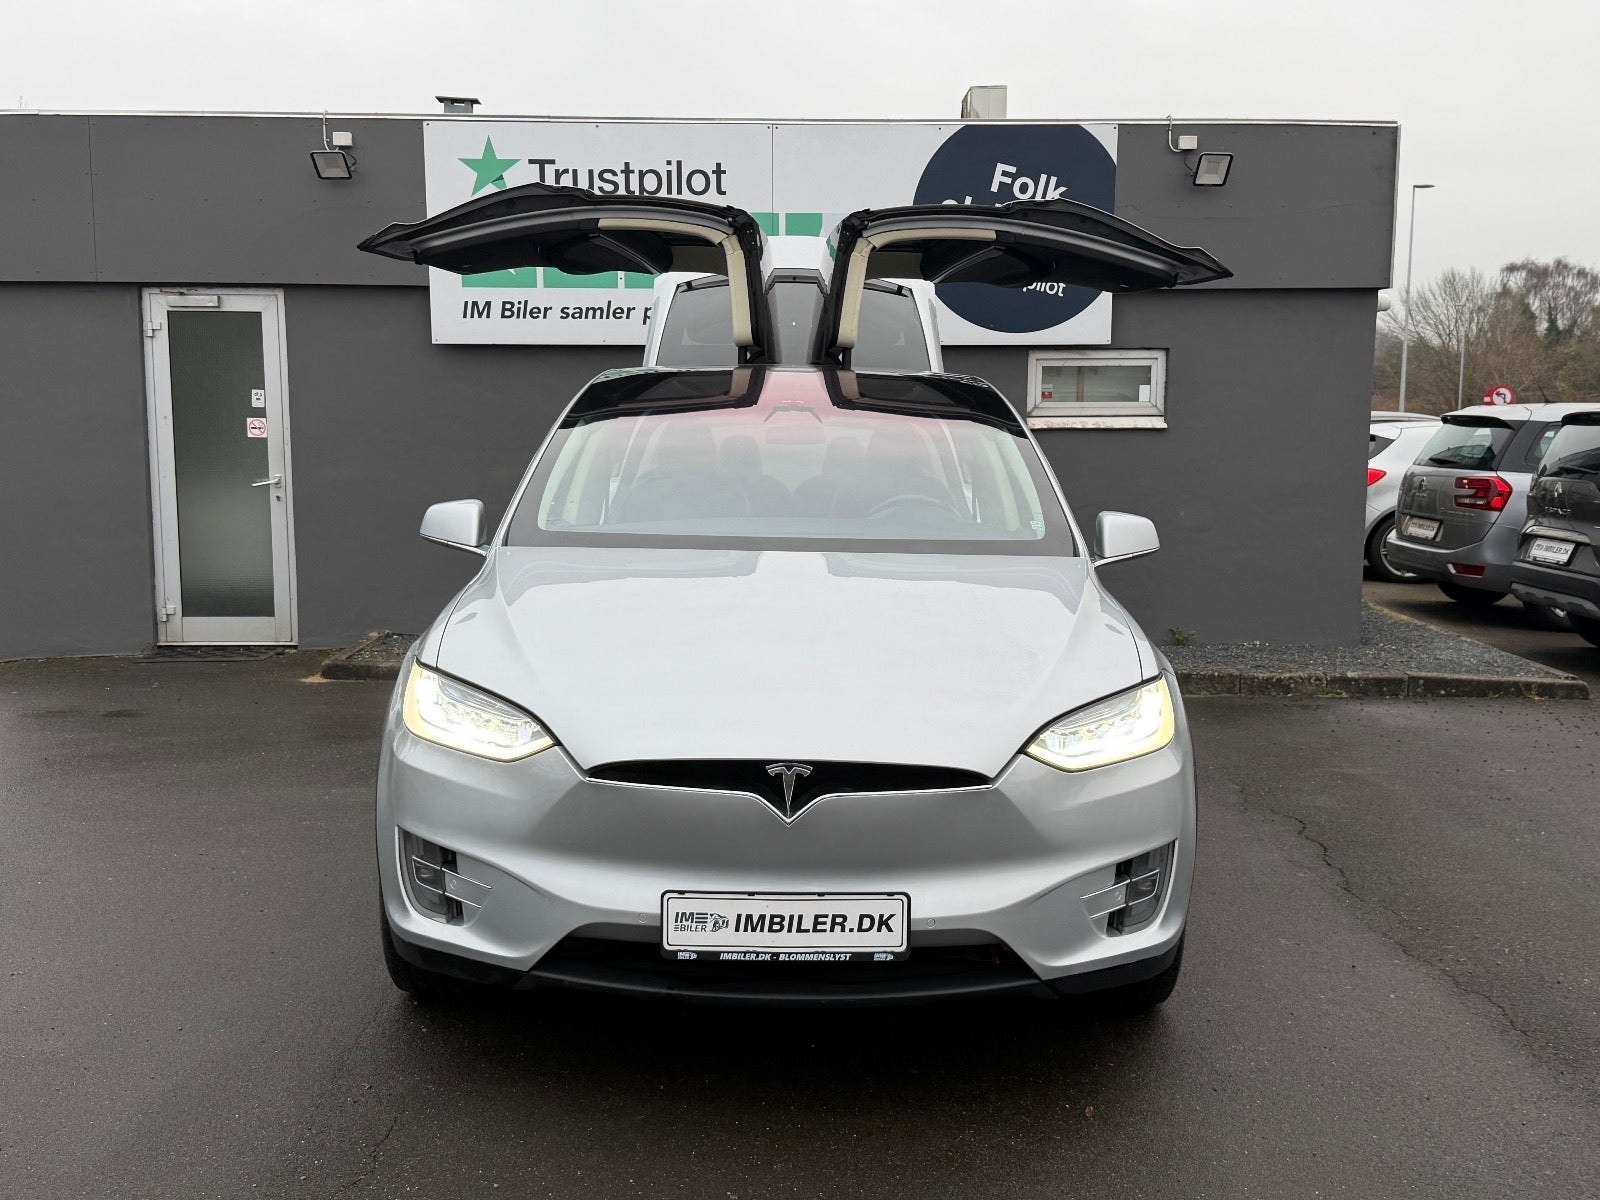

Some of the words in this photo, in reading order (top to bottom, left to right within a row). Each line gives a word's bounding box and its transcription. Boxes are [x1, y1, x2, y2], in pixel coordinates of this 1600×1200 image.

[528, 158, 727, 196] Trustpilot
[990, 162, 1069, 201] Folk
[462, 300, 492, 319] IM
[500, 300, 553, 320] Biler
[559, 300, 636, 320] samler
[734, 913, 897, 934] IMBILER.DK
[719, 952, 771, 961] IMBILER.DK
[778, 953, 852, 961] BLOMMENSLYST
